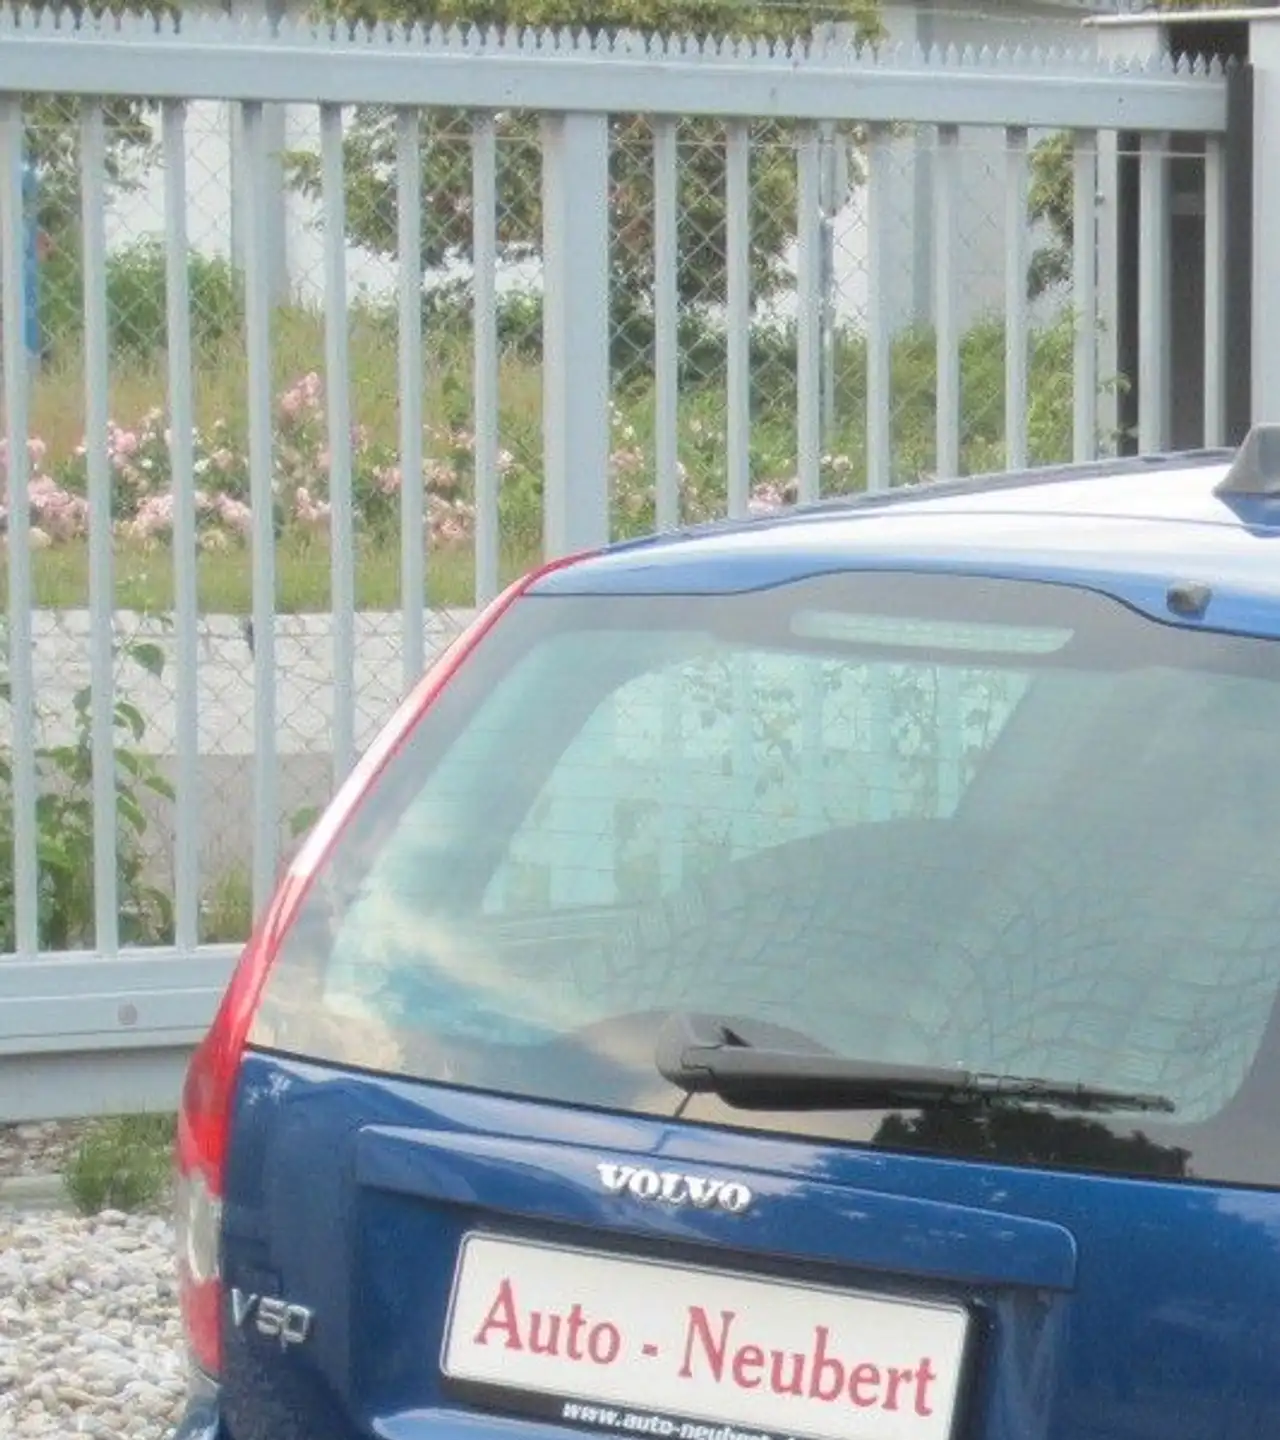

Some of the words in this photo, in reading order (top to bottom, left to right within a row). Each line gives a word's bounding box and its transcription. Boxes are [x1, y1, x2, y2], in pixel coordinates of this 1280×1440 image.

[596, 1163, 752, 1211] VOLVO
[473, 1278, 621, 1365] Auto
[678, 1306, 936, 1417] Neubert
